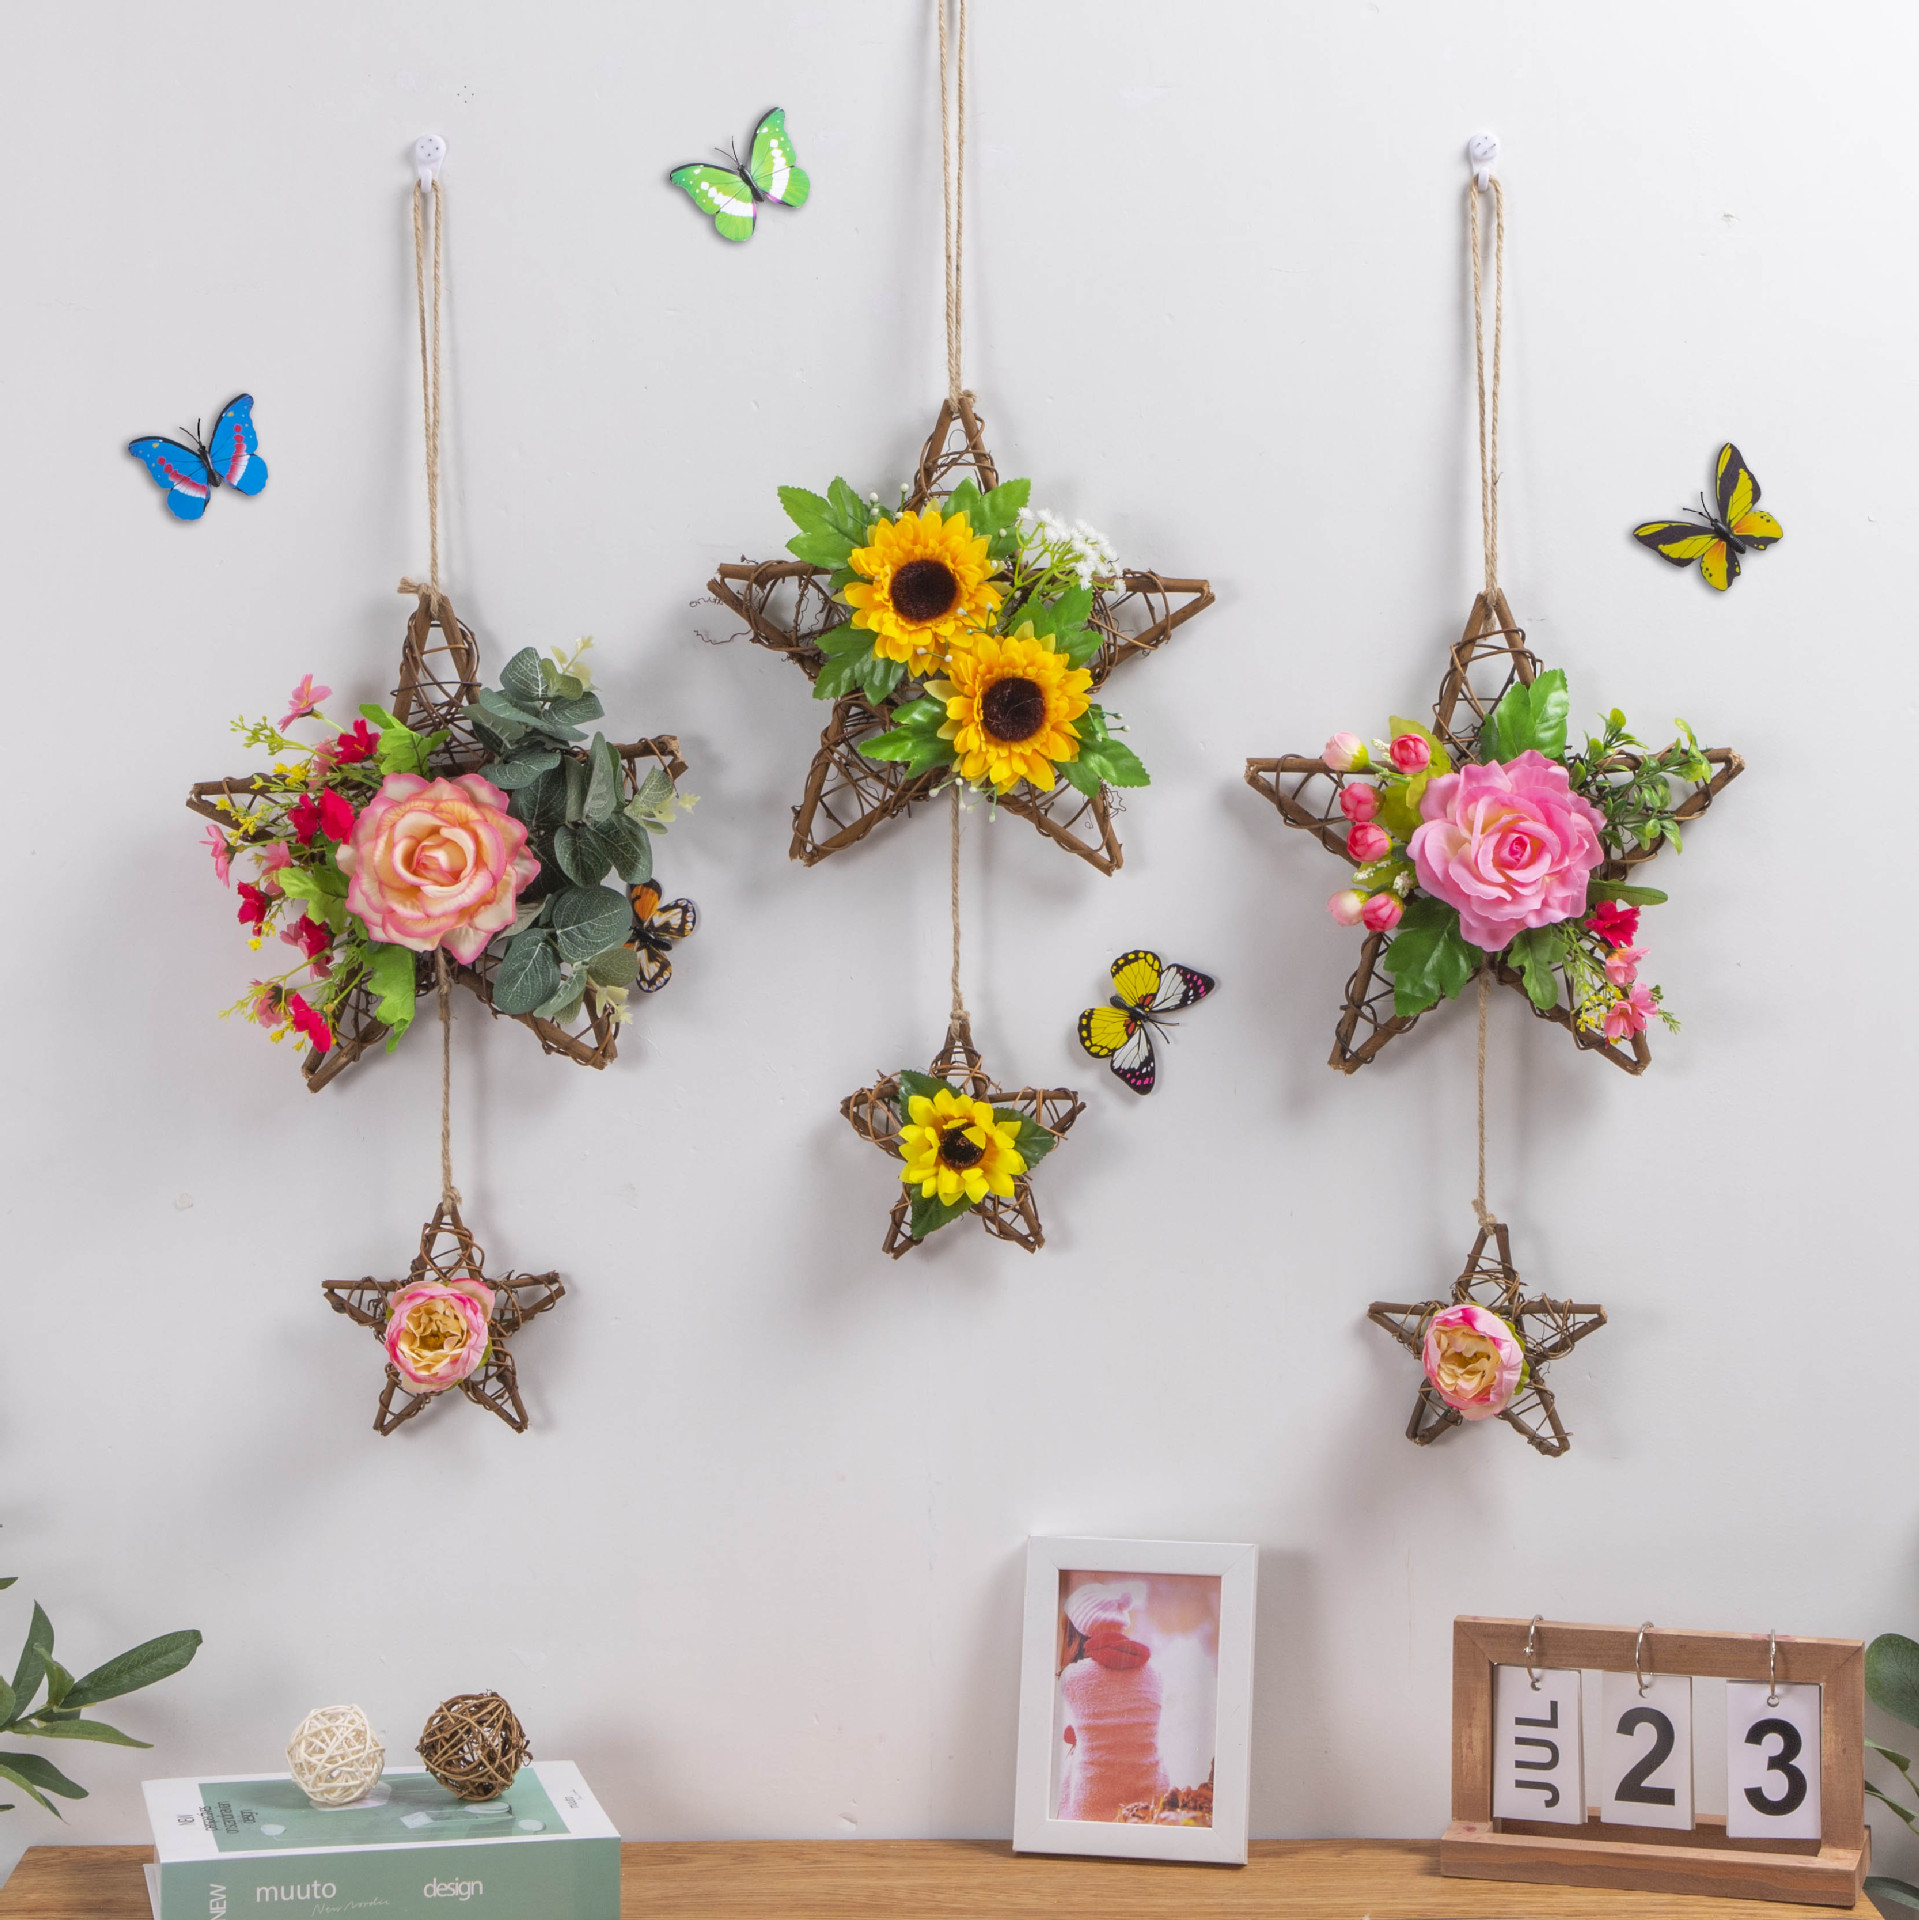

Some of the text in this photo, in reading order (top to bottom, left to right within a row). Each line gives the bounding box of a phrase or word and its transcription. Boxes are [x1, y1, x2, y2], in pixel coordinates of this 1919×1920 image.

[1514, 1700, 1808, 1817] JUL 2 3
[209, 1883, 227, 1920] NEW
[256, 1880, 337, 1902] muuto
[423, 1877, 484, 1901] design
